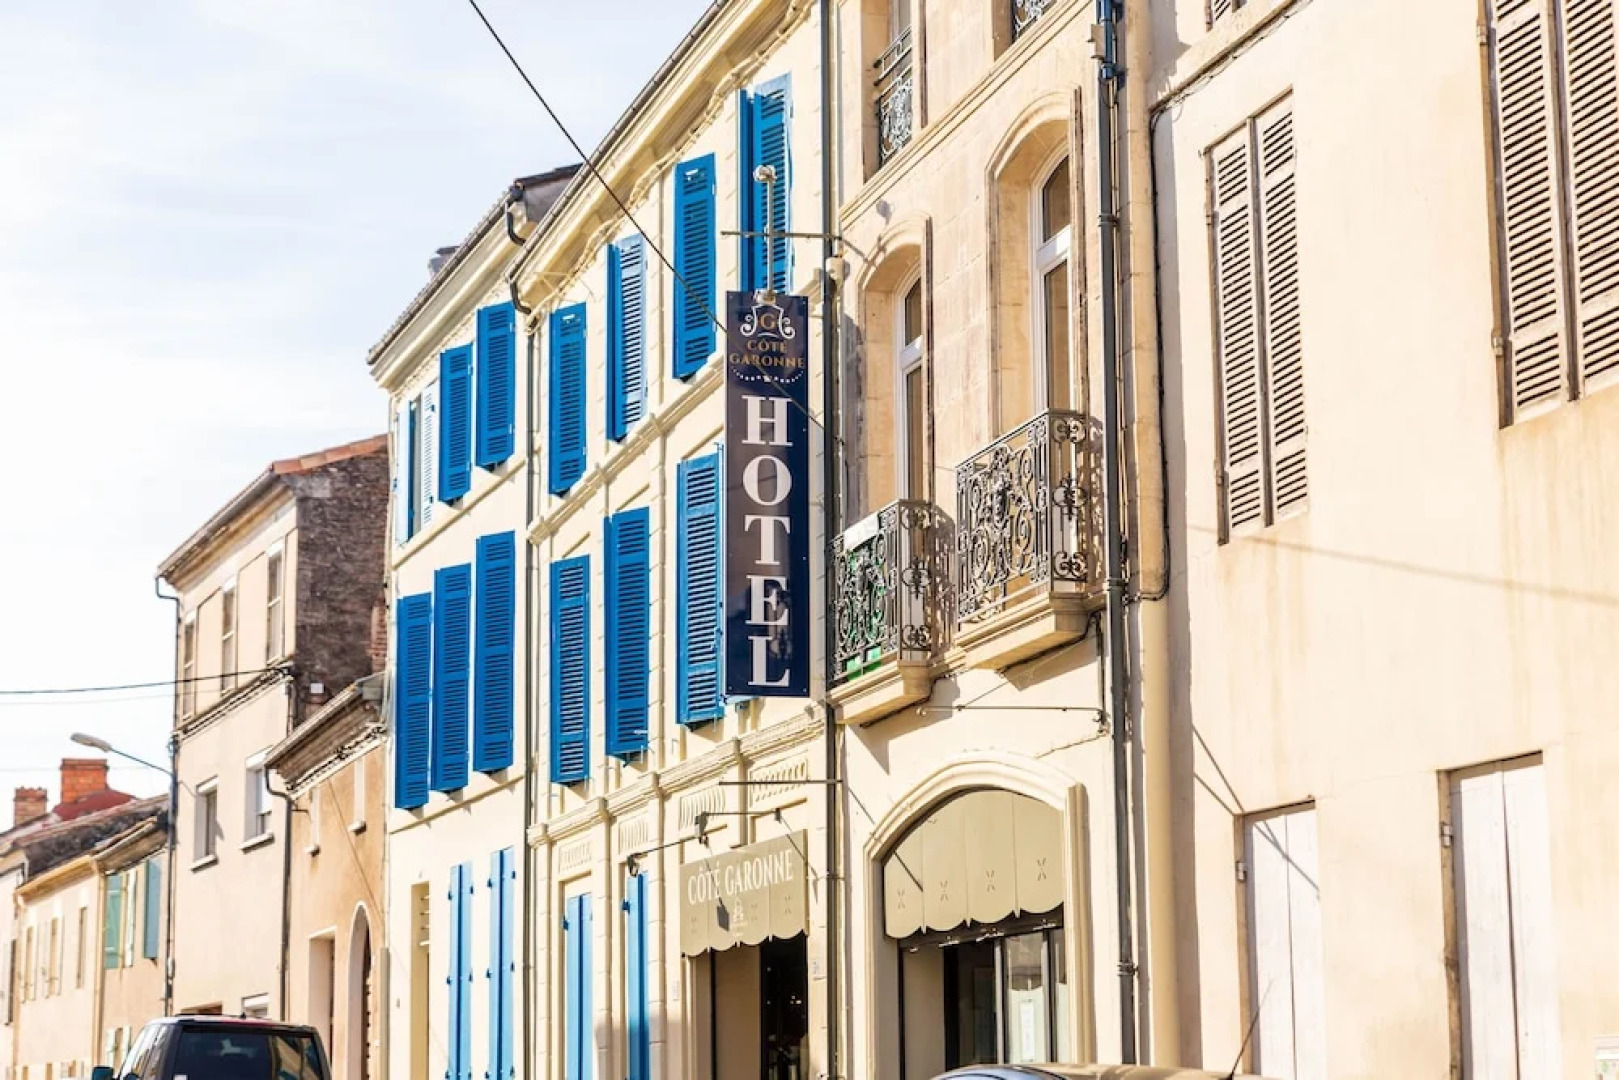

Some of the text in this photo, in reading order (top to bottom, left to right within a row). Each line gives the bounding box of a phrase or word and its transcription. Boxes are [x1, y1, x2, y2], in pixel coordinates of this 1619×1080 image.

[761, 313, 776, 330] G
[729, 352, 805, 368] GARONNE
[741, 394, 793, 687] HOTEL
[725, 849, 793, 895] GARONNE
